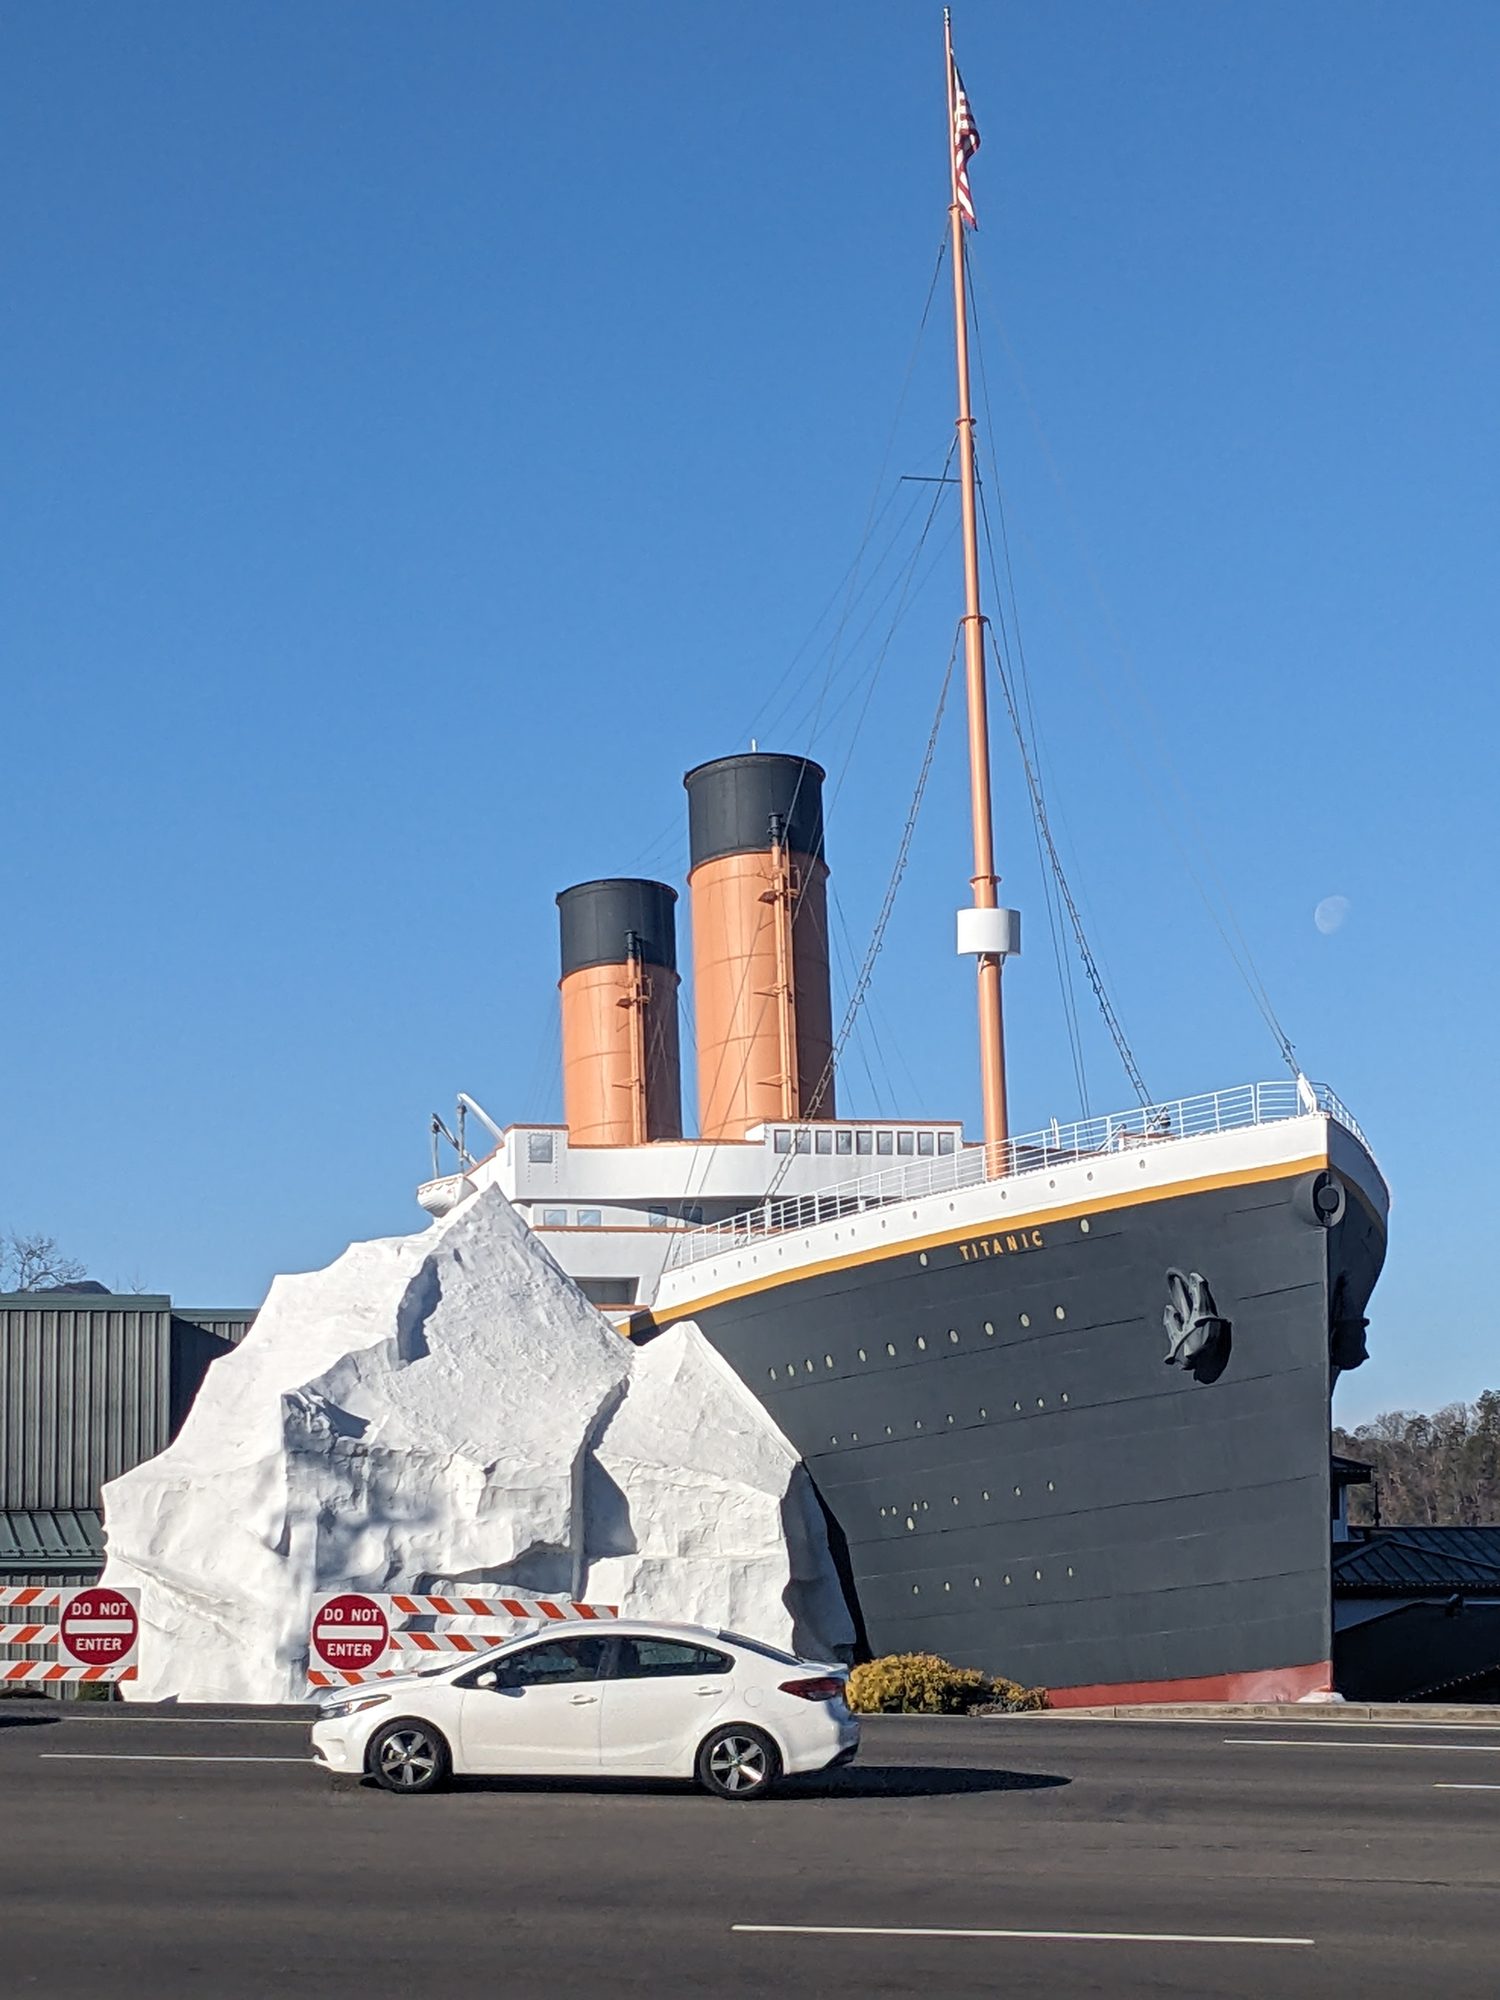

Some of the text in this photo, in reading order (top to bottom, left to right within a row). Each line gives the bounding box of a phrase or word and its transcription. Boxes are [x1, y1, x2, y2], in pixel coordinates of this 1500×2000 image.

[959, 1230, 1044, 1261] TITANIC
[71, 1602, 129, 1616] DO NOT
[324, 1608, 379, 1622] DO NOT
[75, 1638, 122, 1651] ENTER
[327, 1643, 372, 1657] ENTER
